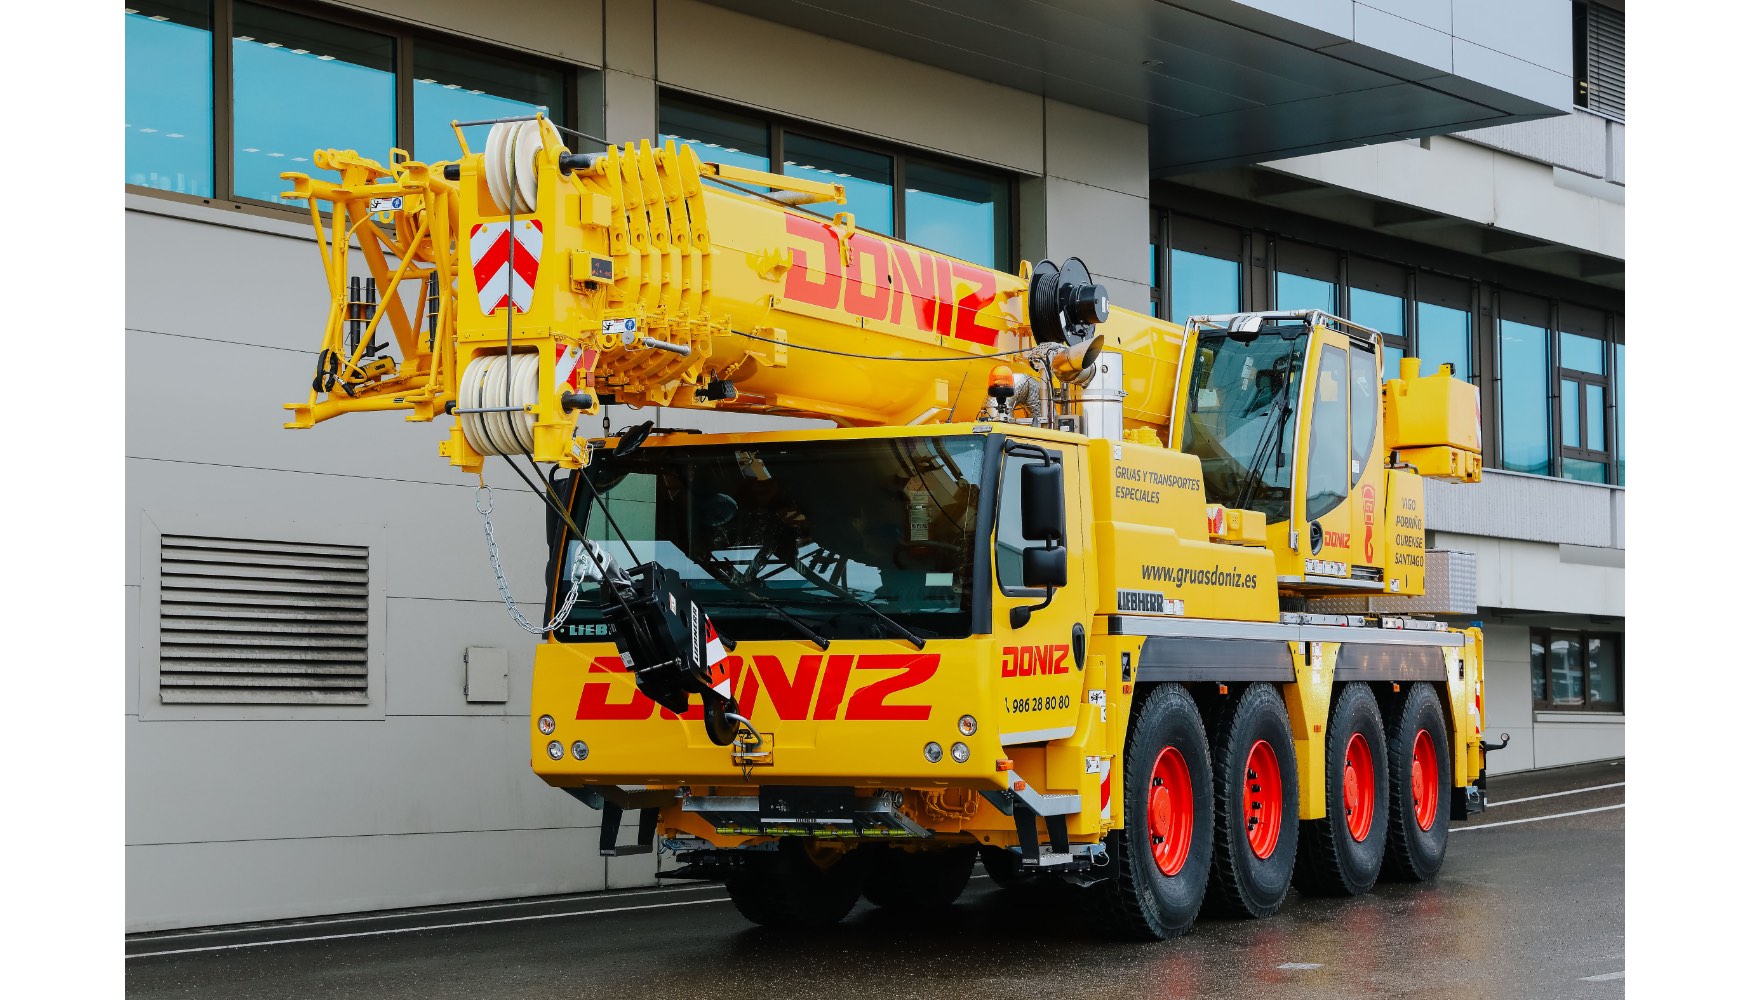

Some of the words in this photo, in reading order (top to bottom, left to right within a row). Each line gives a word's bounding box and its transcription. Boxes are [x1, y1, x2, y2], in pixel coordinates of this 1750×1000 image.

[784, 212, 1000, 348] DONIZ
[1115, 466, 1141, 482] GRUAS
[1143, 471, 1148, 482] Y
[1149, 472, 1200, 491] TRANSPORTES
[1115, 486, 1160, 504] ESPECIALES
[1402, 497, 1416, 511] VIGO
[1324, 531, 1350, 549] DONIZ
[1395, 533, 1423, 549] OURENSE
[1395, 552, 1424, 567] SANTIAGO
[1142, 564, 1257, 589] www.gruasdoniz.es
[1117, 591, 1164, 612] LIEBHERR
[569, 624, 608, 636] LIEB
[1001, 644, 1070, 678] DONIZ
[1012, 698, 1030, 713] 986
[1032, 697, 1043, 711] 28
[1045, 696, 1057, 710] 80
[1058, 695, 1070, 709] 80
